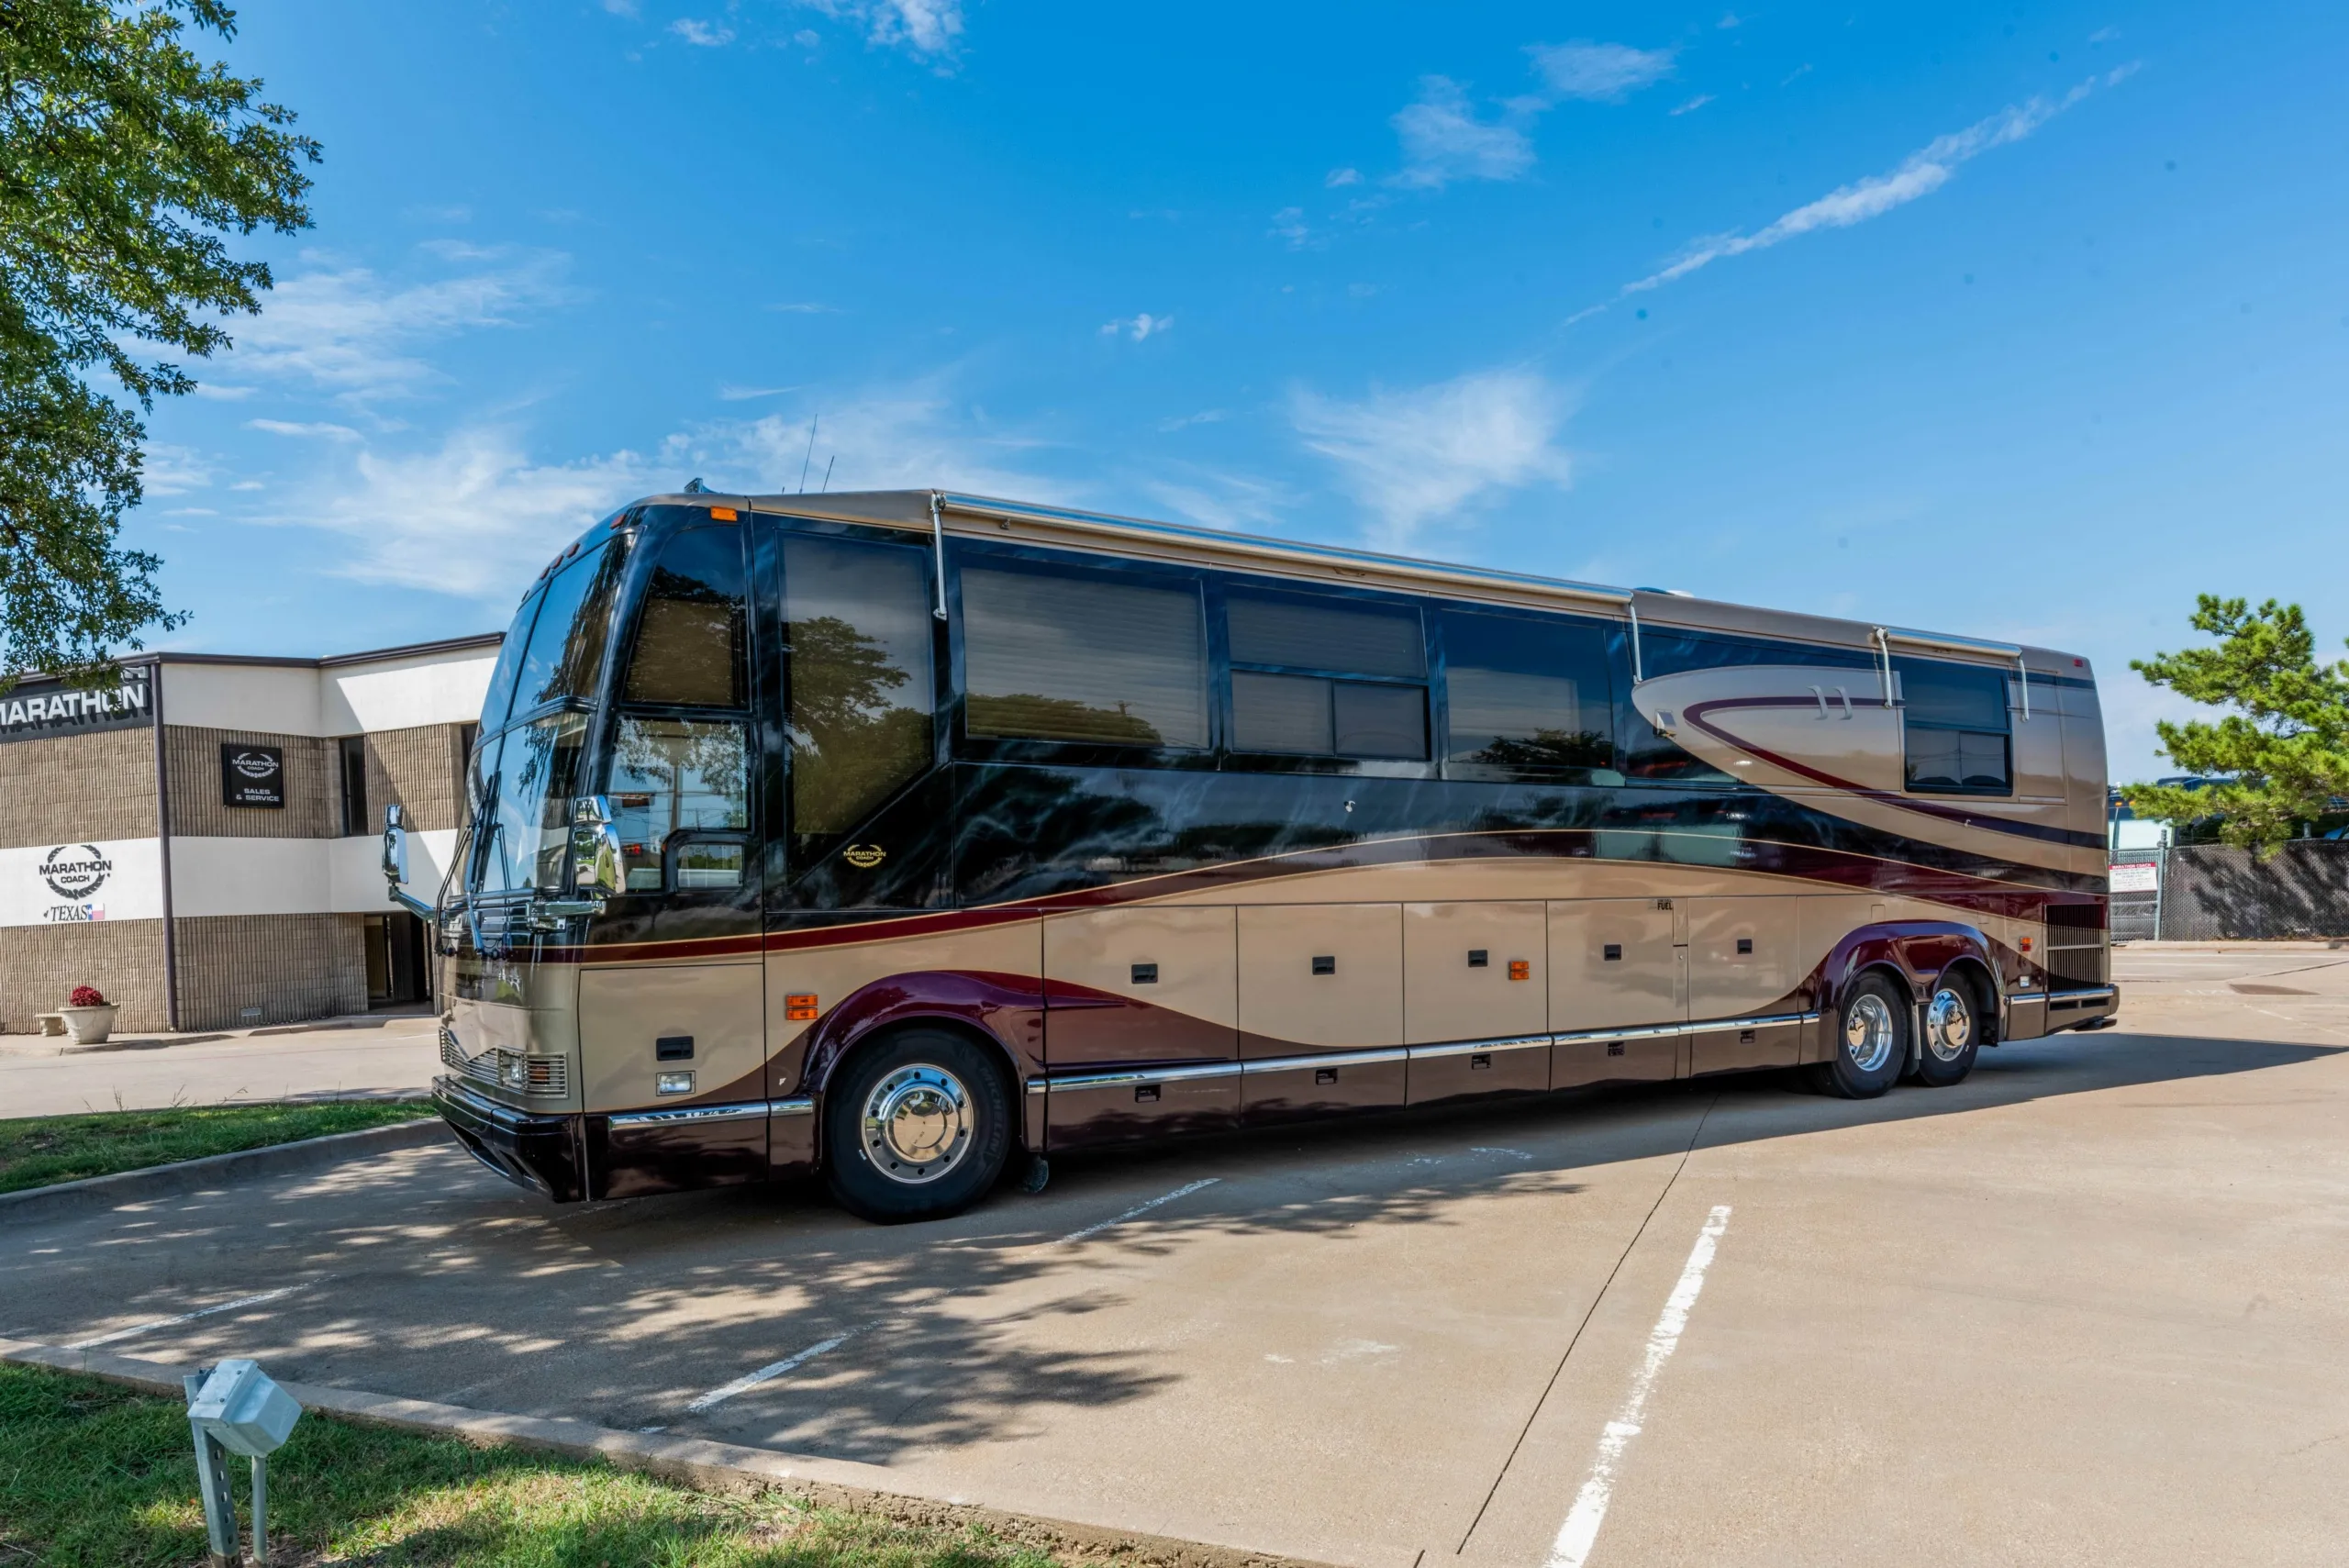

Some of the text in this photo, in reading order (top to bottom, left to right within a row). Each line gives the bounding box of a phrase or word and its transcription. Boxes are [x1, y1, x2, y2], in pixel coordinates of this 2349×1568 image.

[0, 684, 144, 726] ARATHON
[232, 759, 279, 767] MARATHON
[39, 860, 112, 875] MARATHON
[61, 874, 90, 884] COACH
[1657, 902, 1673, 910] FUEL
[50, 905, 89, 921] TEXAS
